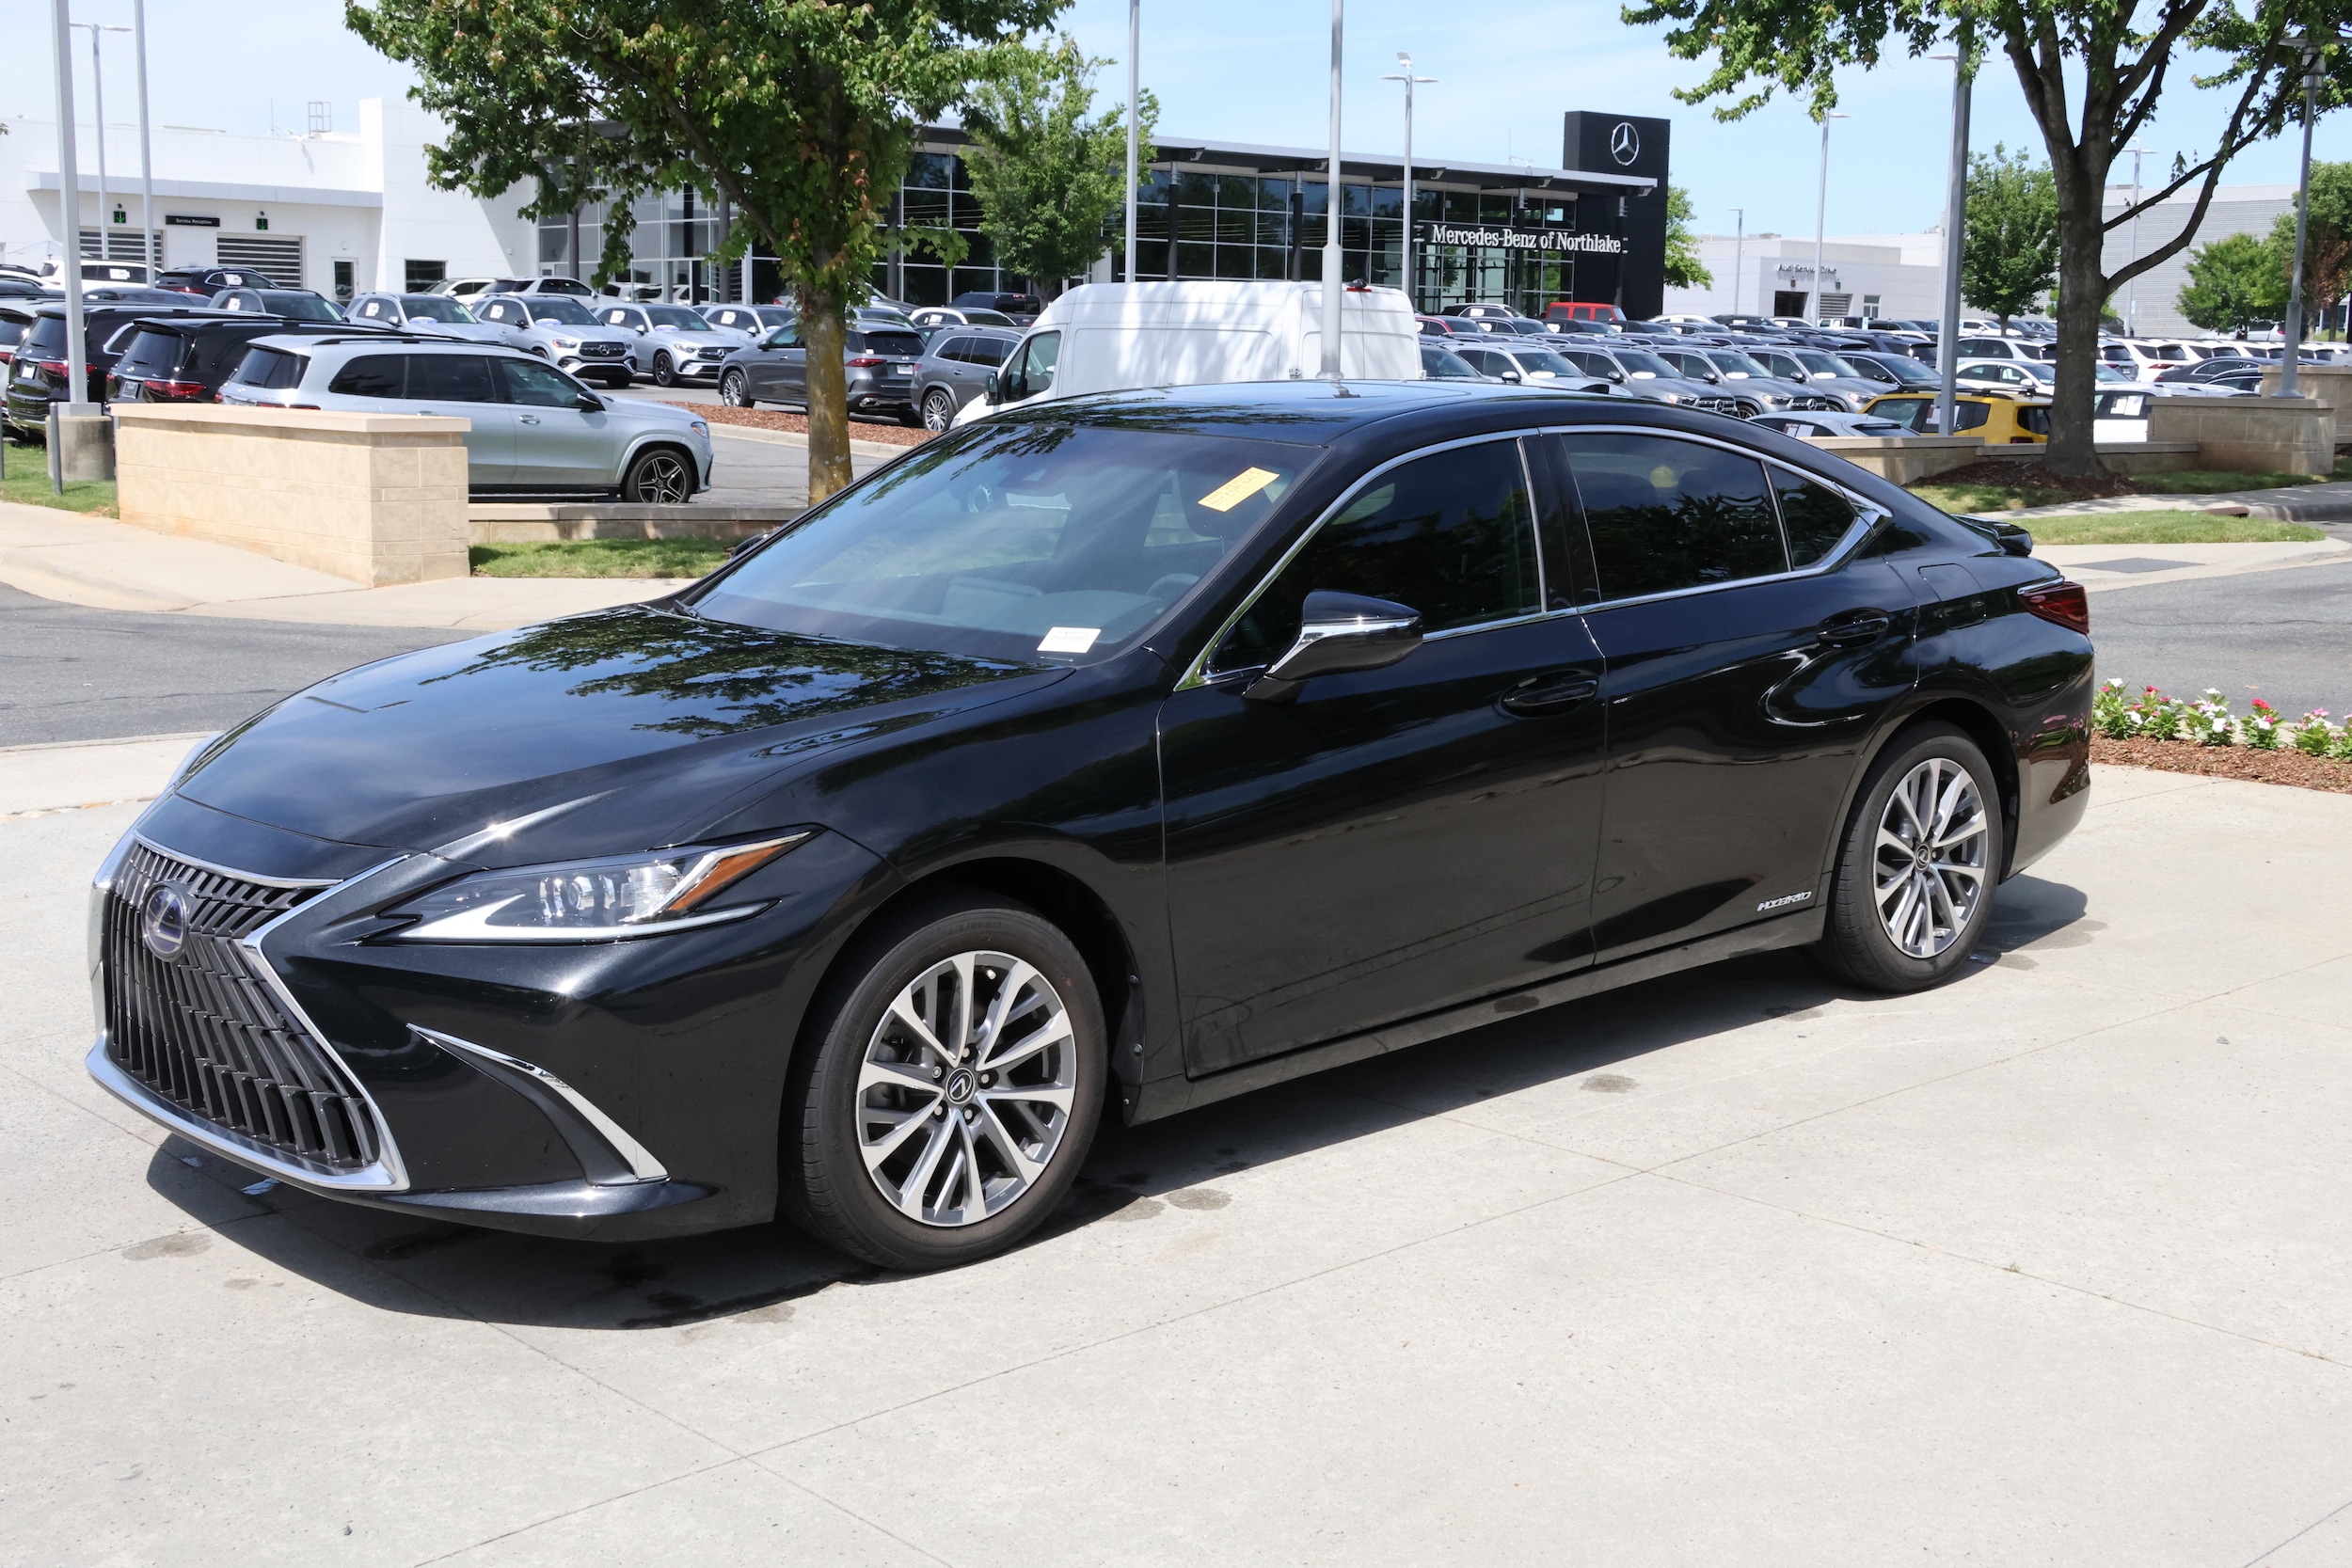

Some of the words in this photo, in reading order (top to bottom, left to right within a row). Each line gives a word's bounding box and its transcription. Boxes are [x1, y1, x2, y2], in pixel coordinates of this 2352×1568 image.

[1432, 224, 1537, 248] Mercedes-Benz
[1540, 231, 1555, 249] of
[1556, 231, 1621, 254] Northlake
[1778, 263, 1794, 272] Audi
[1795, 264, 1816, 273] Servic
[1756, 891, 1812, 911] HYBRID
